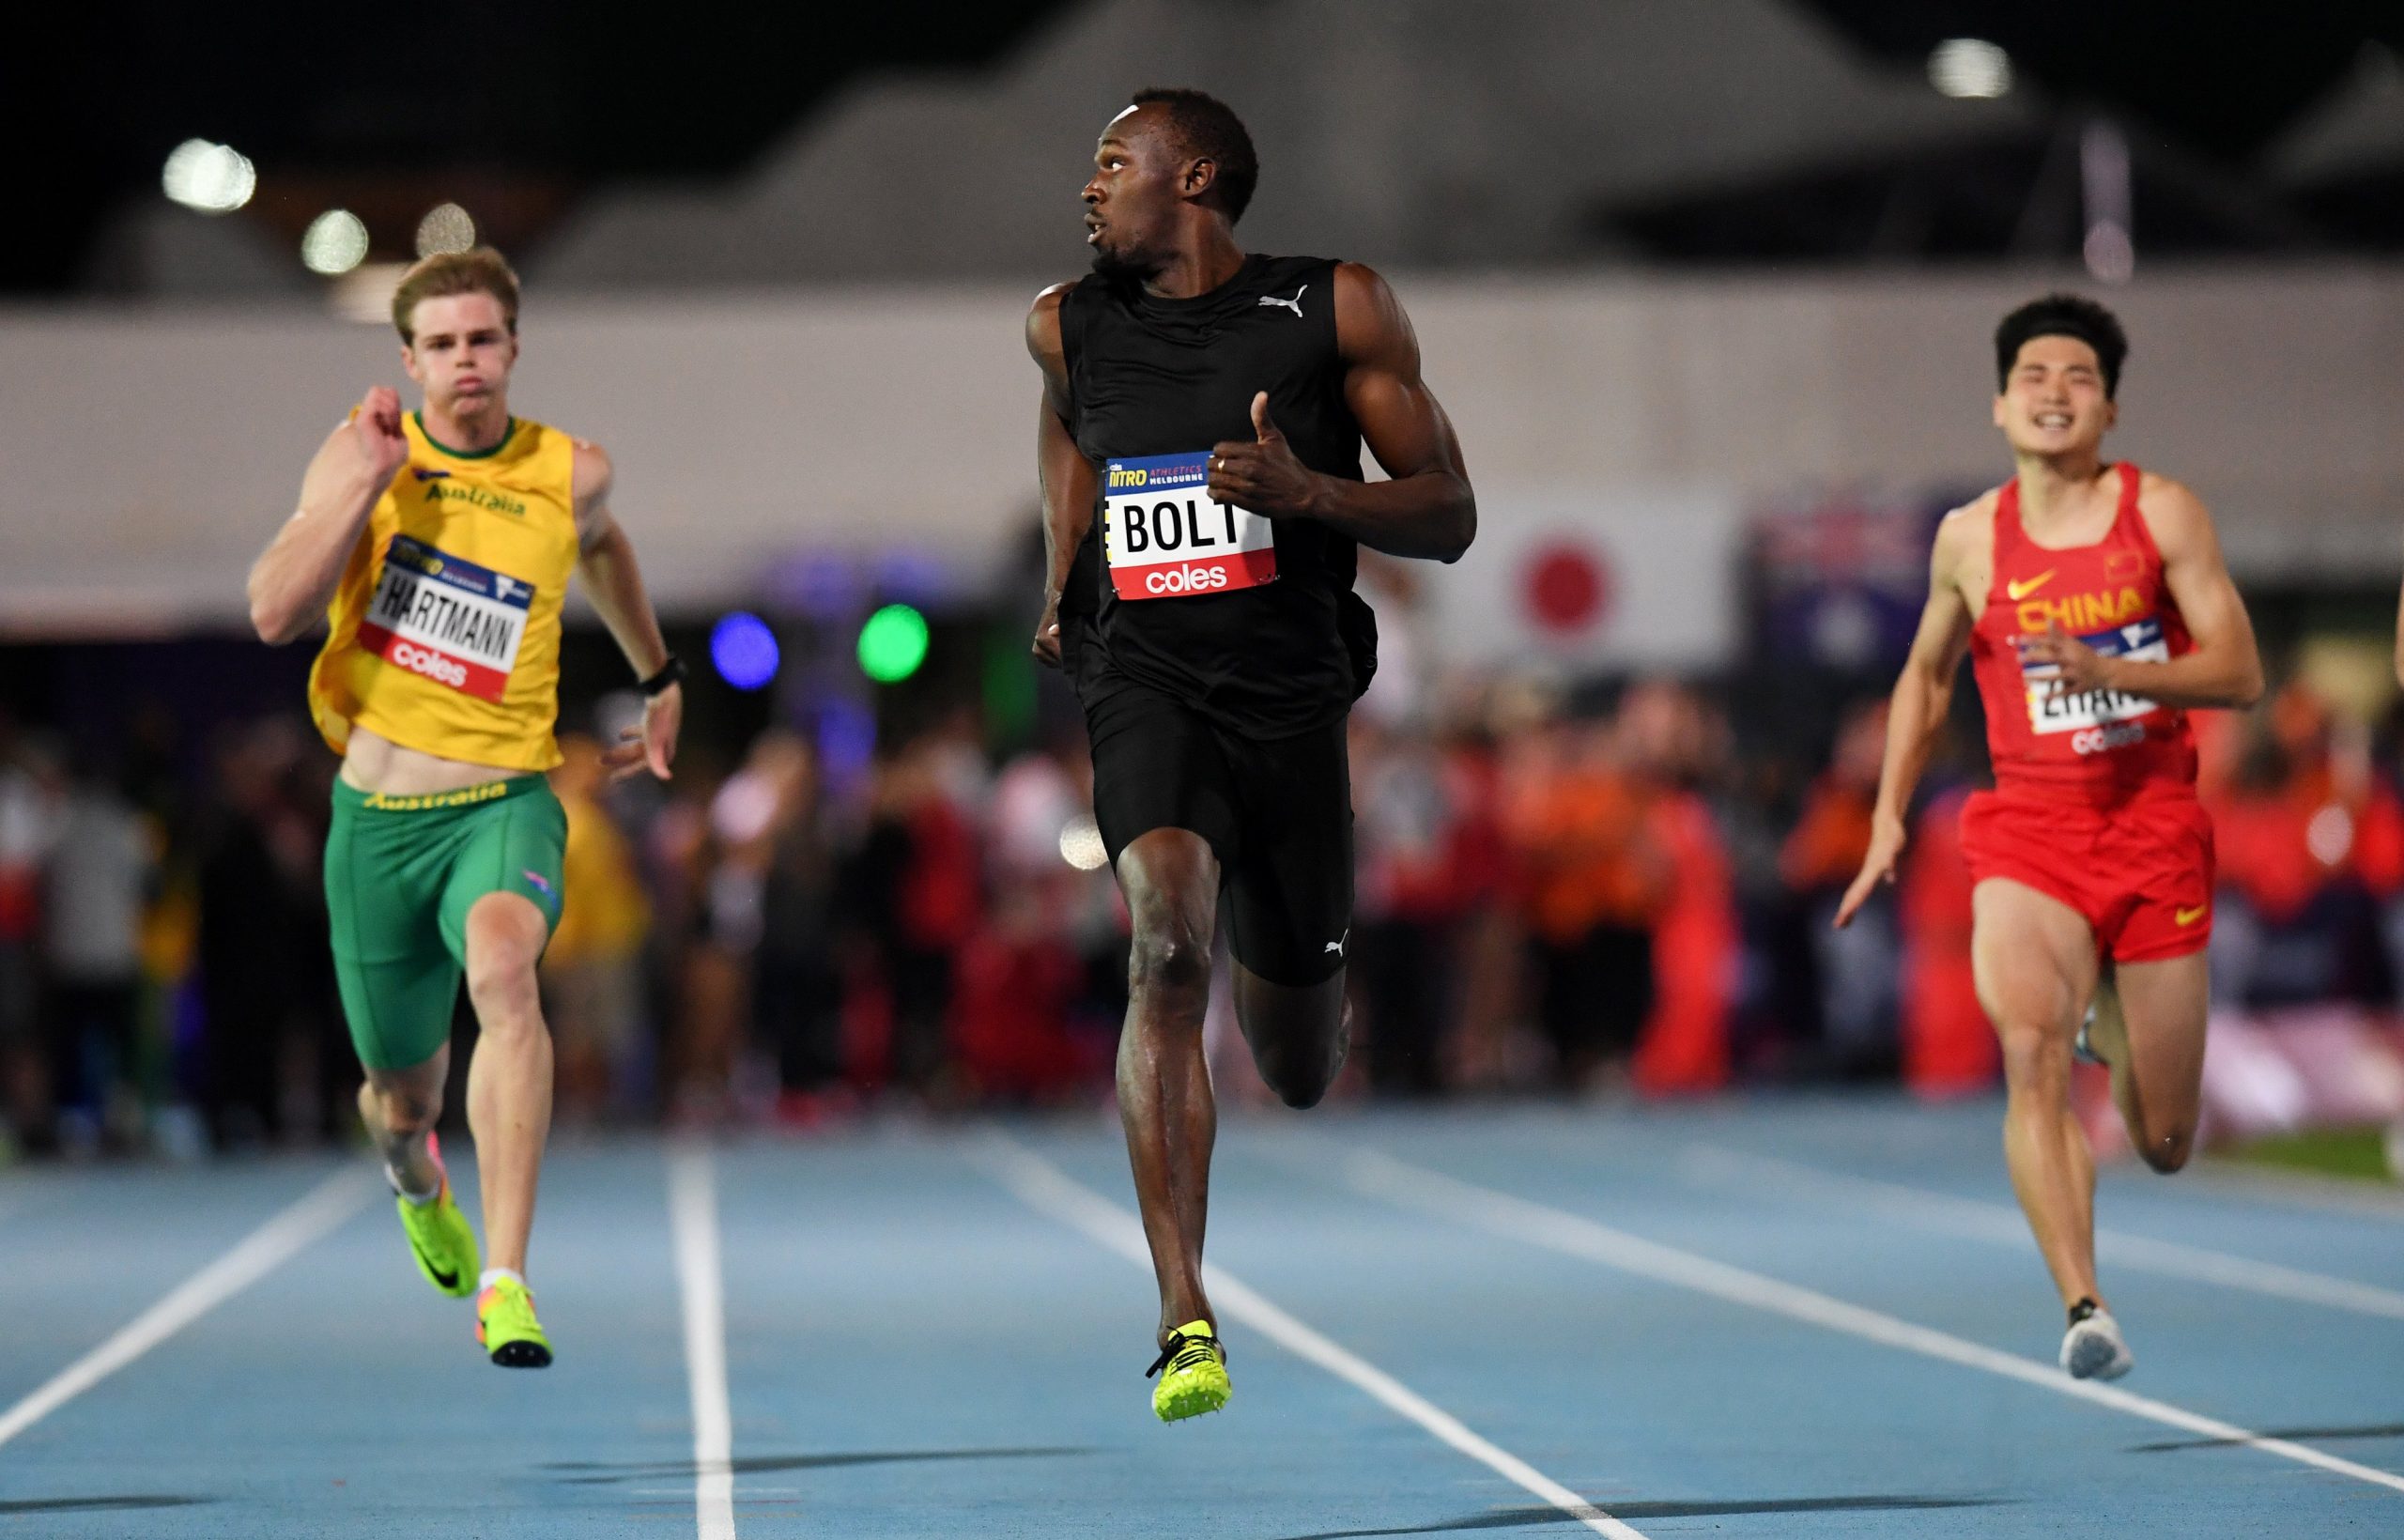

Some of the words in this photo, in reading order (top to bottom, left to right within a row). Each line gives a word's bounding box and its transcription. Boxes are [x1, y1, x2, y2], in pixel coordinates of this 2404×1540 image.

[1109, 470, 1148, 487] NITRO
[1149, 465, 1202, 477] ATHLETICS
[1149, 473, 1204, 485] MELBOURNE
[425, 484, 526, 516] Australia
[1124, 500, 1238, 553] BOLT
[1146, 563, 1227, 593] coles
[380, 574, 515, 660] HARTMANN
[2016, 586, 2146, 632] CHINA
[393, 642, 468, 687] coles
[363, 781, 507, 811] Australia
